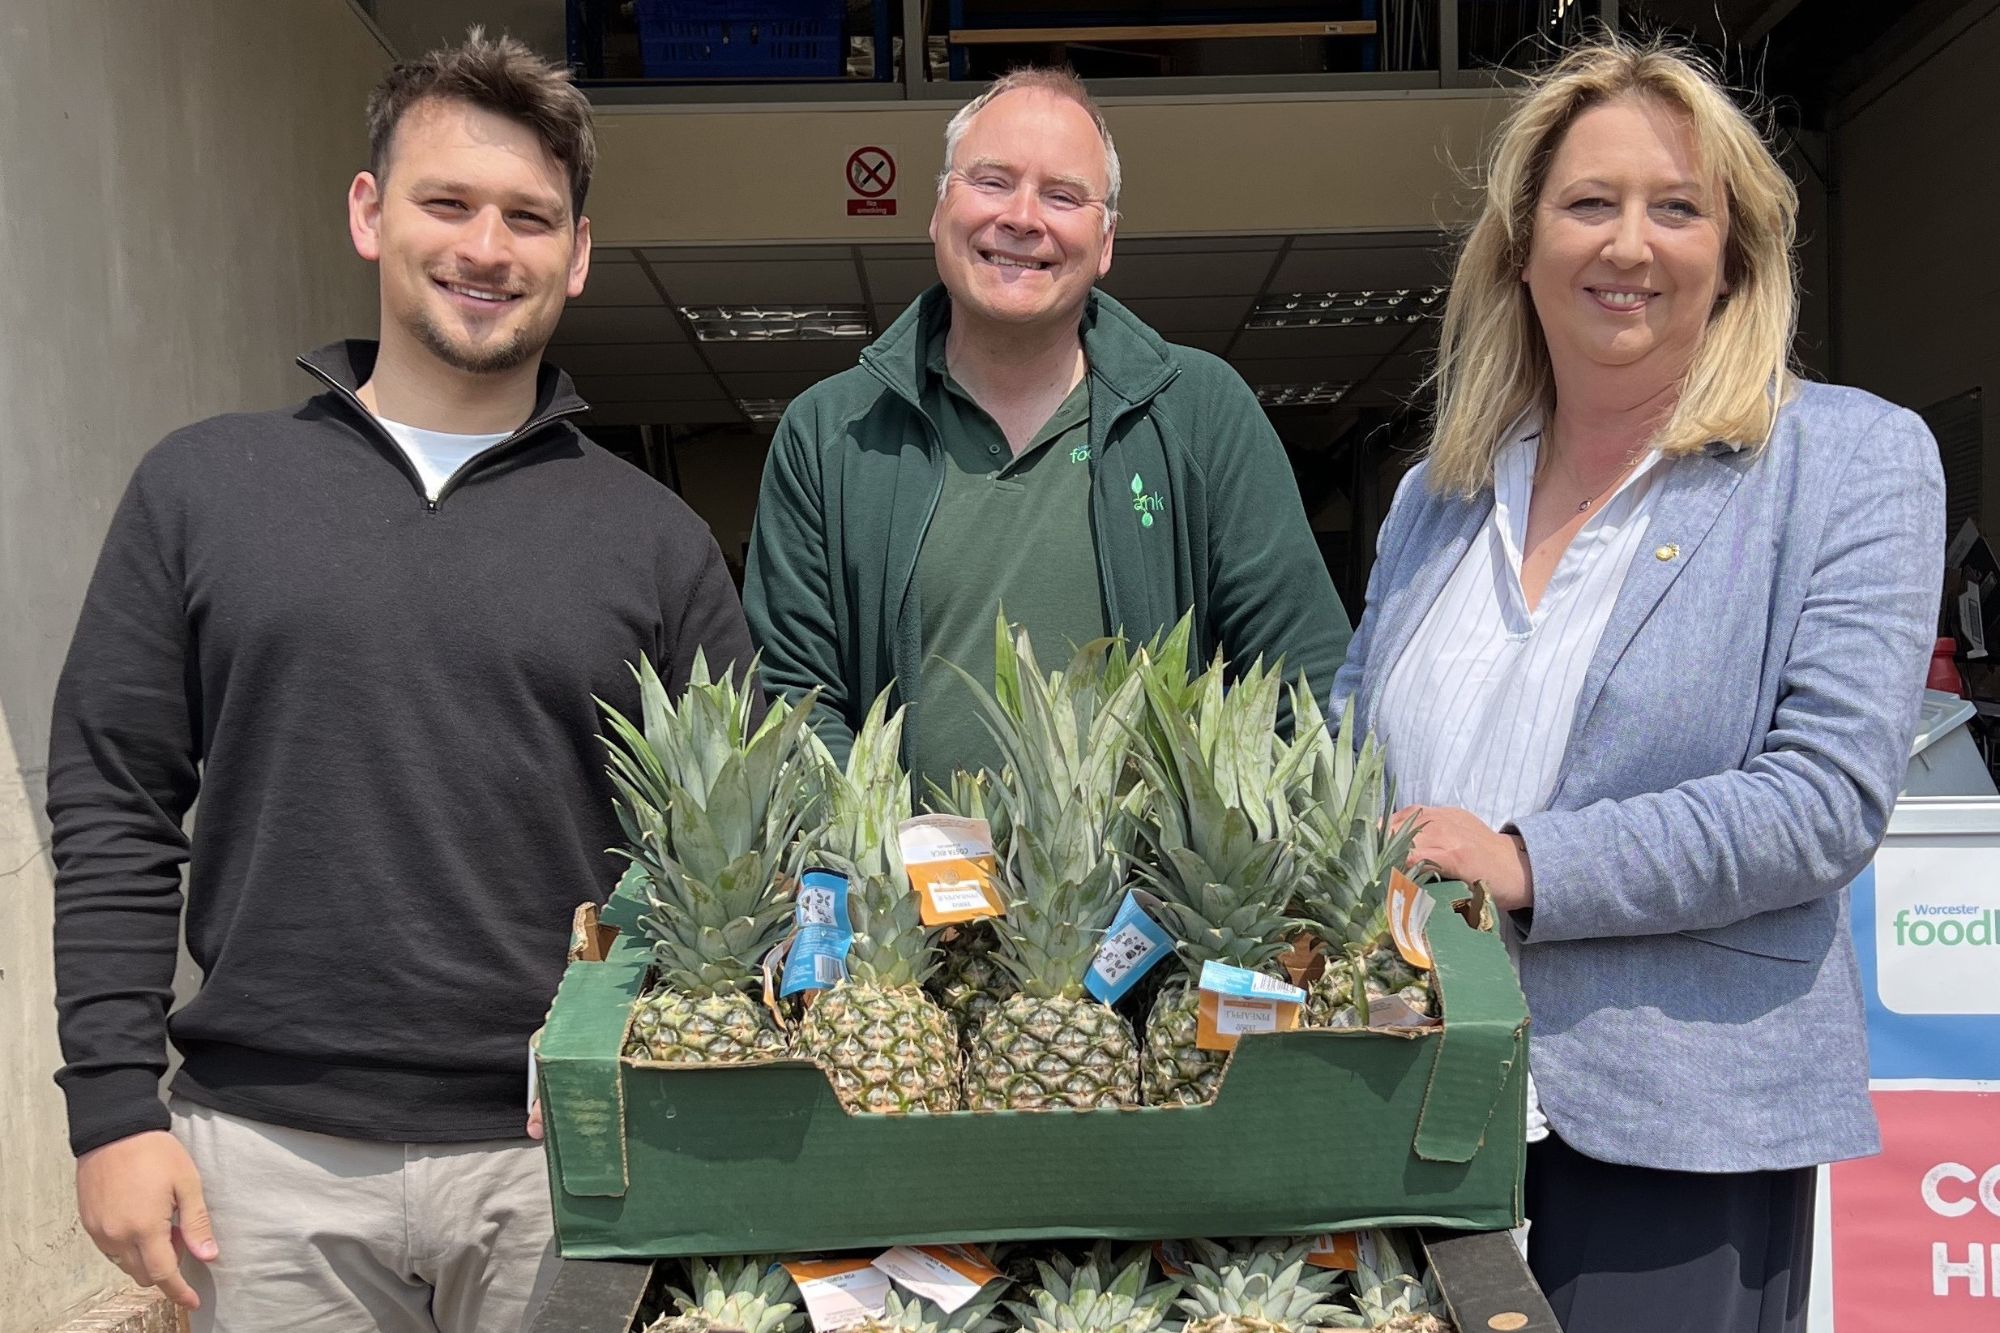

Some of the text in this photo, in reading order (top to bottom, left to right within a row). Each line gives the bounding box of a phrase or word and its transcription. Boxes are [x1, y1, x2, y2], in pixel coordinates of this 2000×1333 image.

[1914, 904, 1980, 915] Worcester
[1893, 909, 2000, 946] food
[1225, 1009, 1270, 1022] PINEAPPLE
[1932, 1241, 2000, 1297] H
